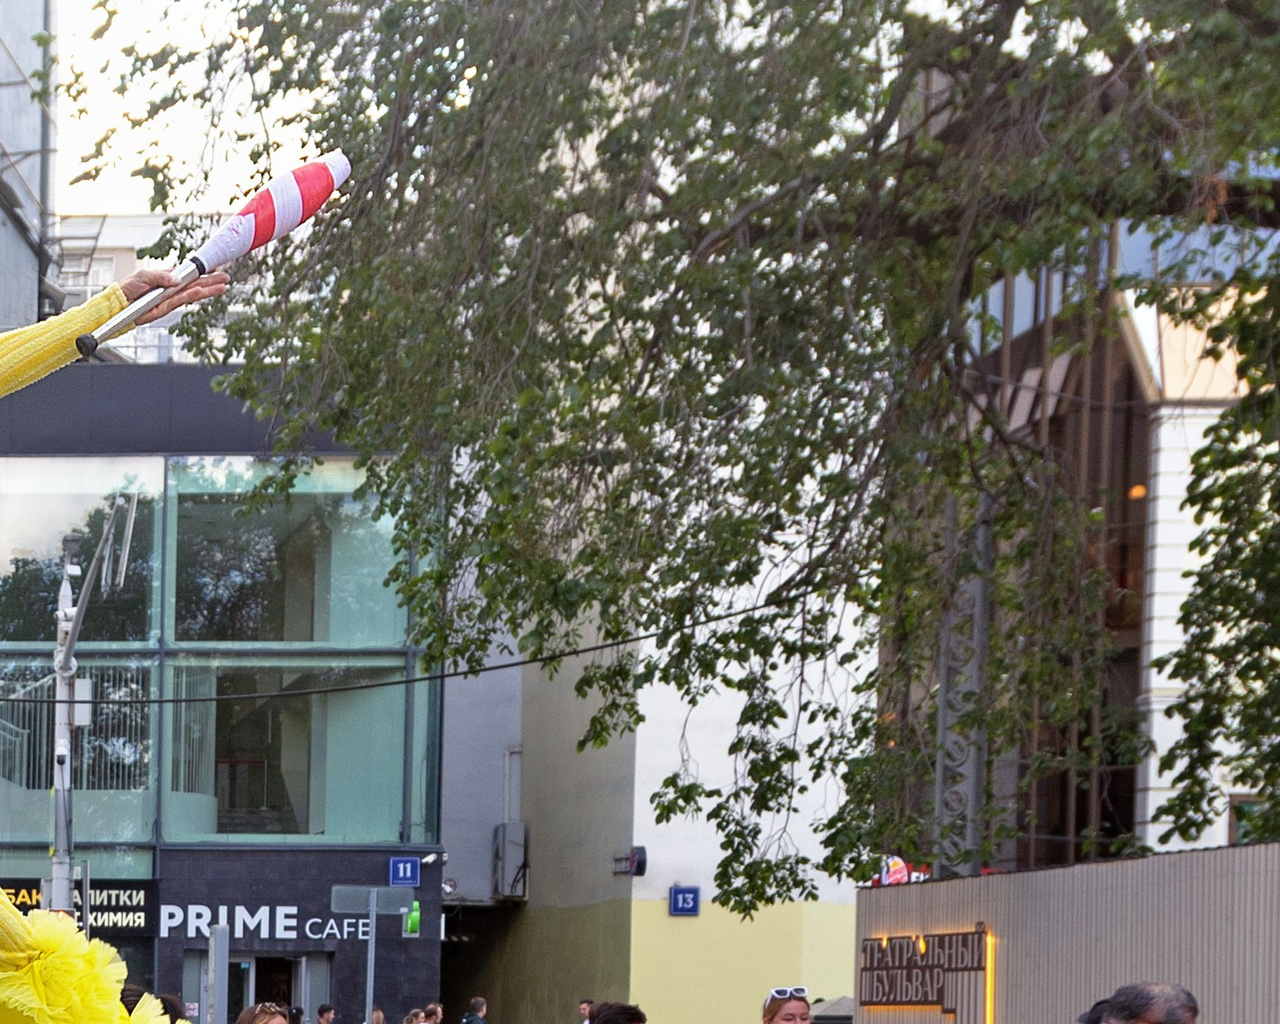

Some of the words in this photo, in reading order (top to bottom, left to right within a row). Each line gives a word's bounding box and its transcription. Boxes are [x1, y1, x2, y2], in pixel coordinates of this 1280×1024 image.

[397, 862, 412, 878] 11
[677, 893, 695, 909] 13
[160, 904, 298, 939] PRIME
[305, 918, 370, 939] CAFE
[863, 928, 986, 969] ТЕАТРАЛЬНЫЙ
[872, 968, 944, 1003] БУЛЬВАР
